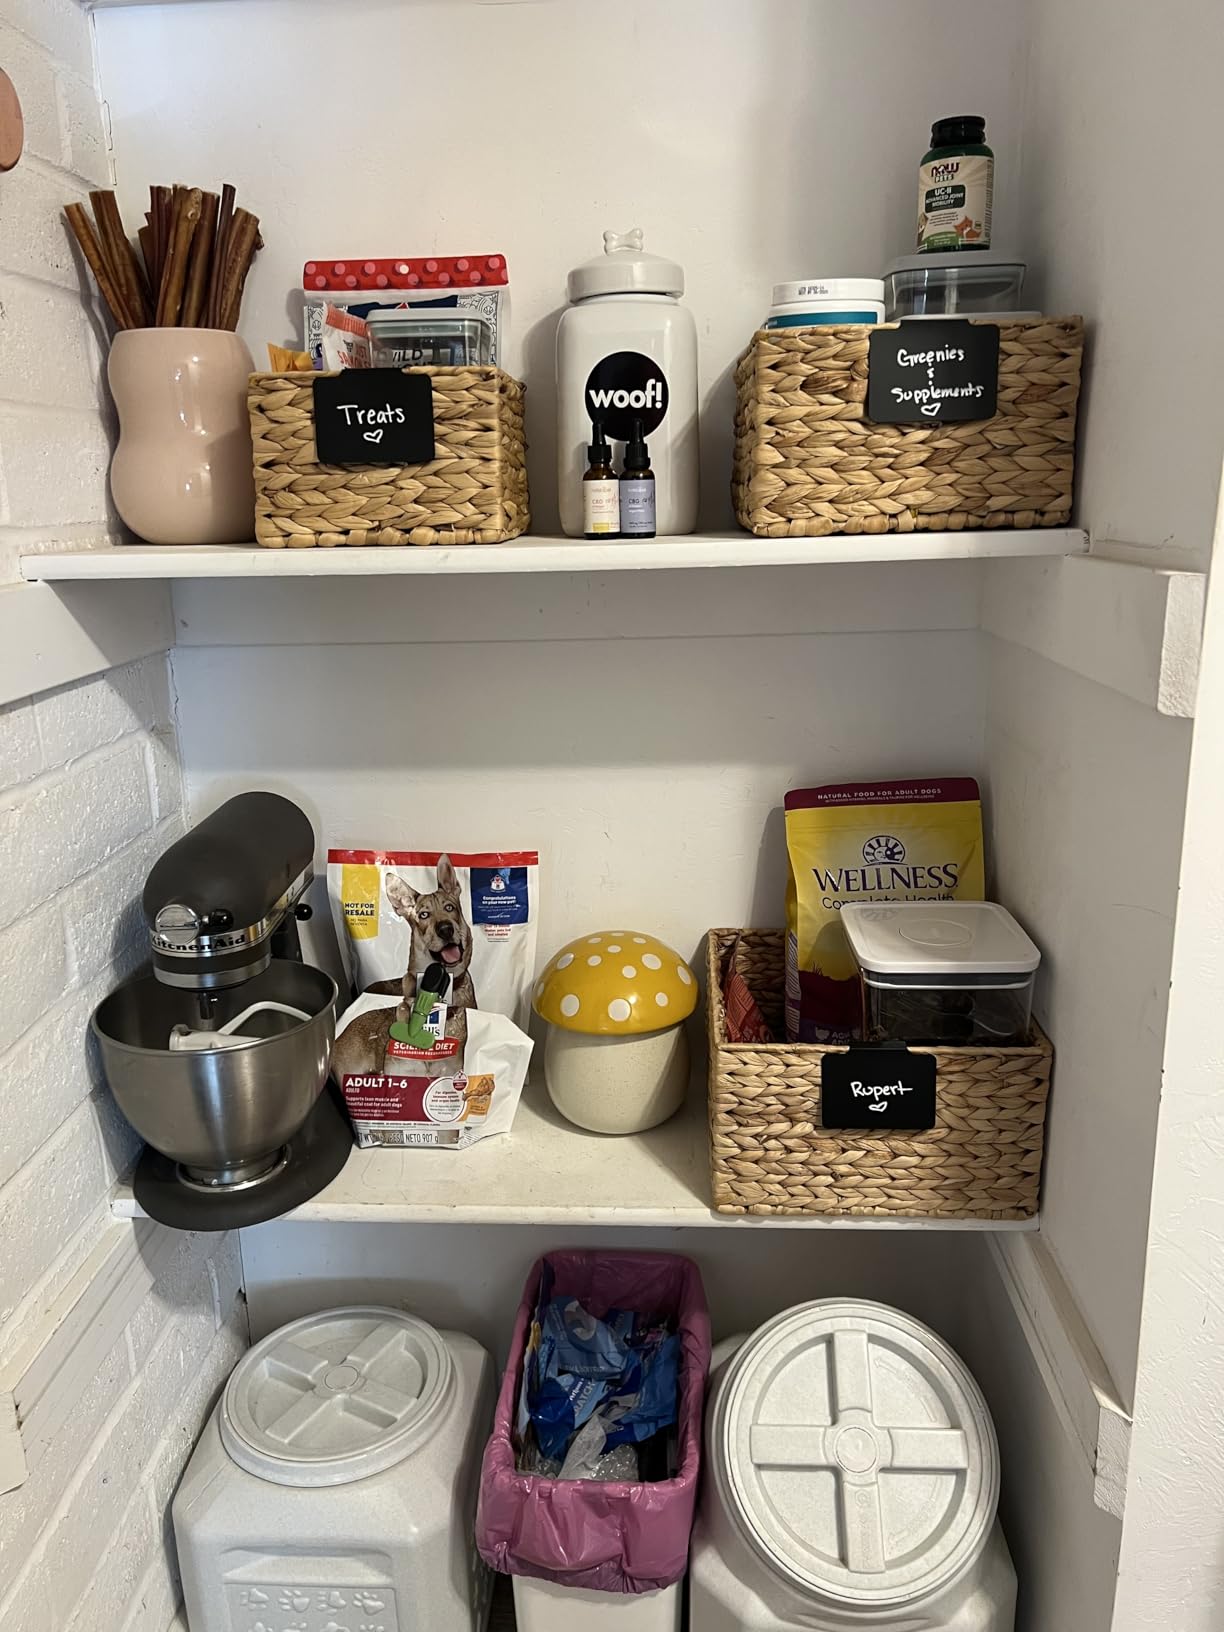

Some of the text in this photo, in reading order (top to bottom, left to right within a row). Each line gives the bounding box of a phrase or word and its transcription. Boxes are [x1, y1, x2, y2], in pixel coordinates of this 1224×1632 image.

[897, 344, 965, 367] Greenies
[588, 378, 663, 409] woof!
[890, 382, 985, 404] Supplements
[336, 403, 405, 426] Treats
[817, 792, 852, 800] NATURAL
[812, 863, 958, 892] WELLNESS
[435, 1042, 455, 1051] DIET
[345, 1077, 385, 1088] ADULT
[850, 1080, 914, 1101] Rupert
[405, 1133, 421, 1143] NETO
[422, 1133, 433, 1143] 907
